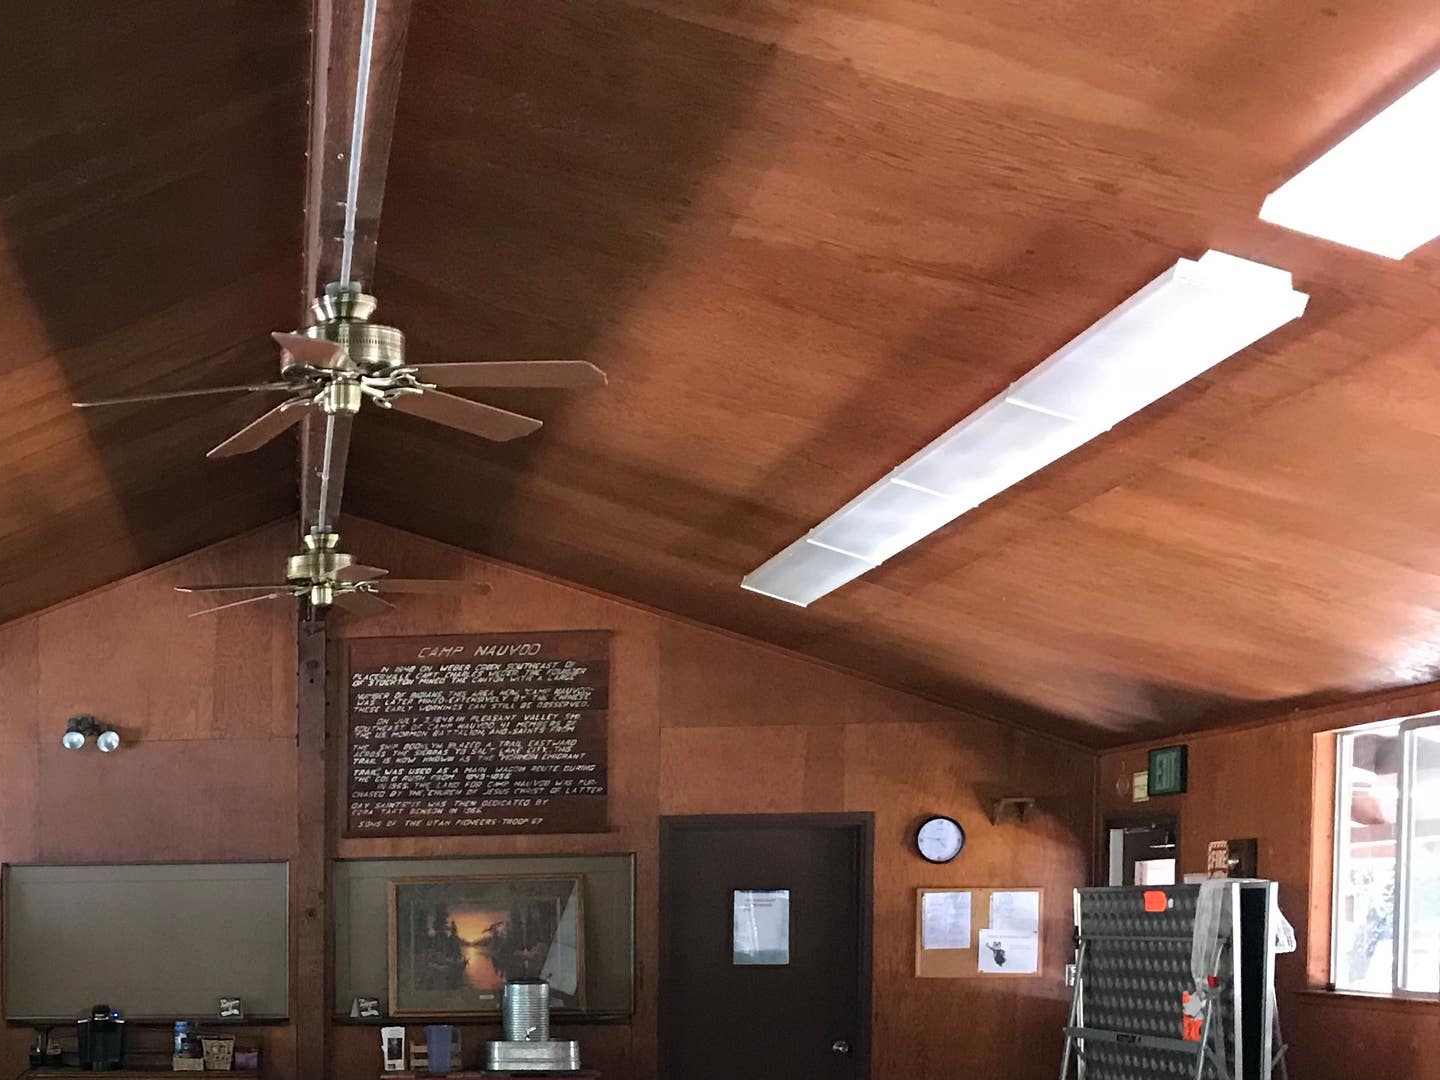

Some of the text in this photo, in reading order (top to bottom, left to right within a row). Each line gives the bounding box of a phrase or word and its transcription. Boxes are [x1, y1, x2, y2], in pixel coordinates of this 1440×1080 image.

[418, 647, 464, 658] CAMP
[507, 662, 559, 670] SOUTHEAST
[419, 704, 463, 712] WORKINGS
[470, 714, 517, 722] PLEASANT
[354, 724, 406, 732] SOUTHEAST
[1155, 752, 1177, 790] EXIT
[352, 790, 385, 798] CHASED
[481, 799, 531, 807] DEDICATED
